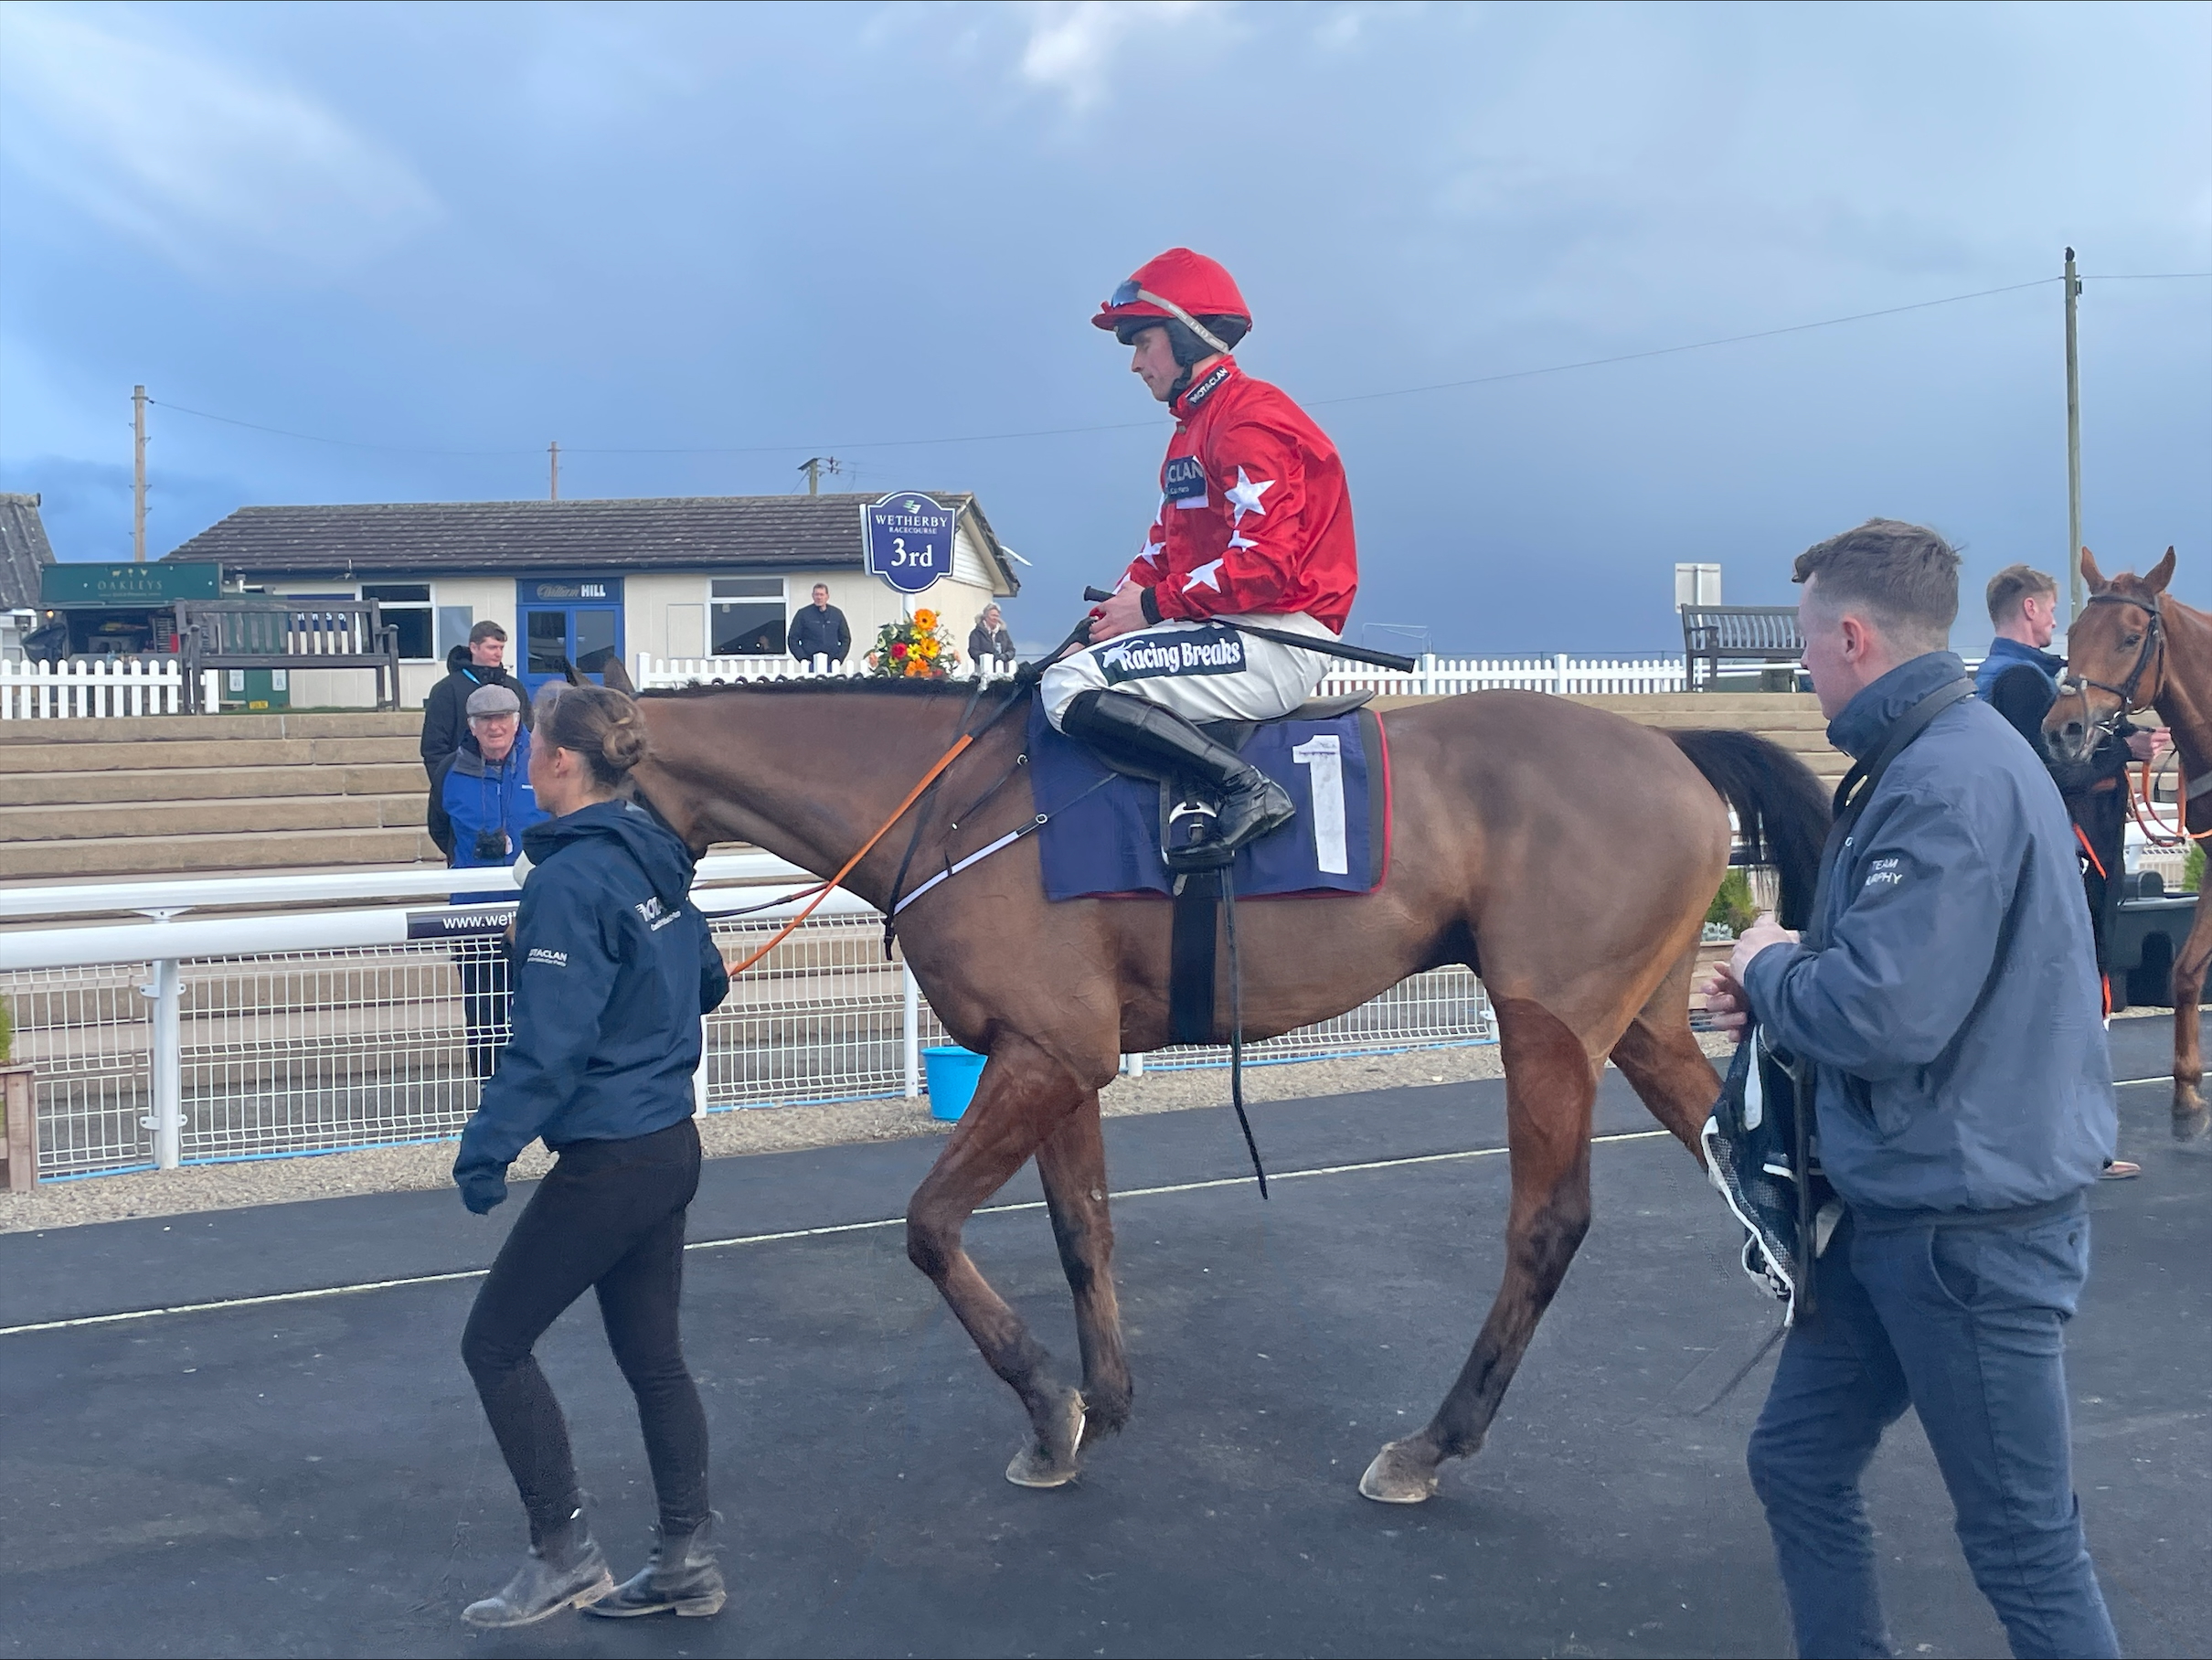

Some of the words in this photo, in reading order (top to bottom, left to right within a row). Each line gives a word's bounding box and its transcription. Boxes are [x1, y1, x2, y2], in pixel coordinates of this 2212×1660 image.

[1189, 367, 1228, 404] MOTACLAN
[875, 514, 948, 527] WETHERBY
[888, 527, 938, 535] RACECOURSE
[890, 537, 933, 568] 3rd
[97, 580, 163, 591] OAKLEYS
[580, 584, 606, 598] HILL
[1116, 641, 1181, 674] Racing
[1180, 637, 1242, 667] Breaks
[1292, 734, 1348, 875] 1
[1872, 857, 1899, 870] TEAM
